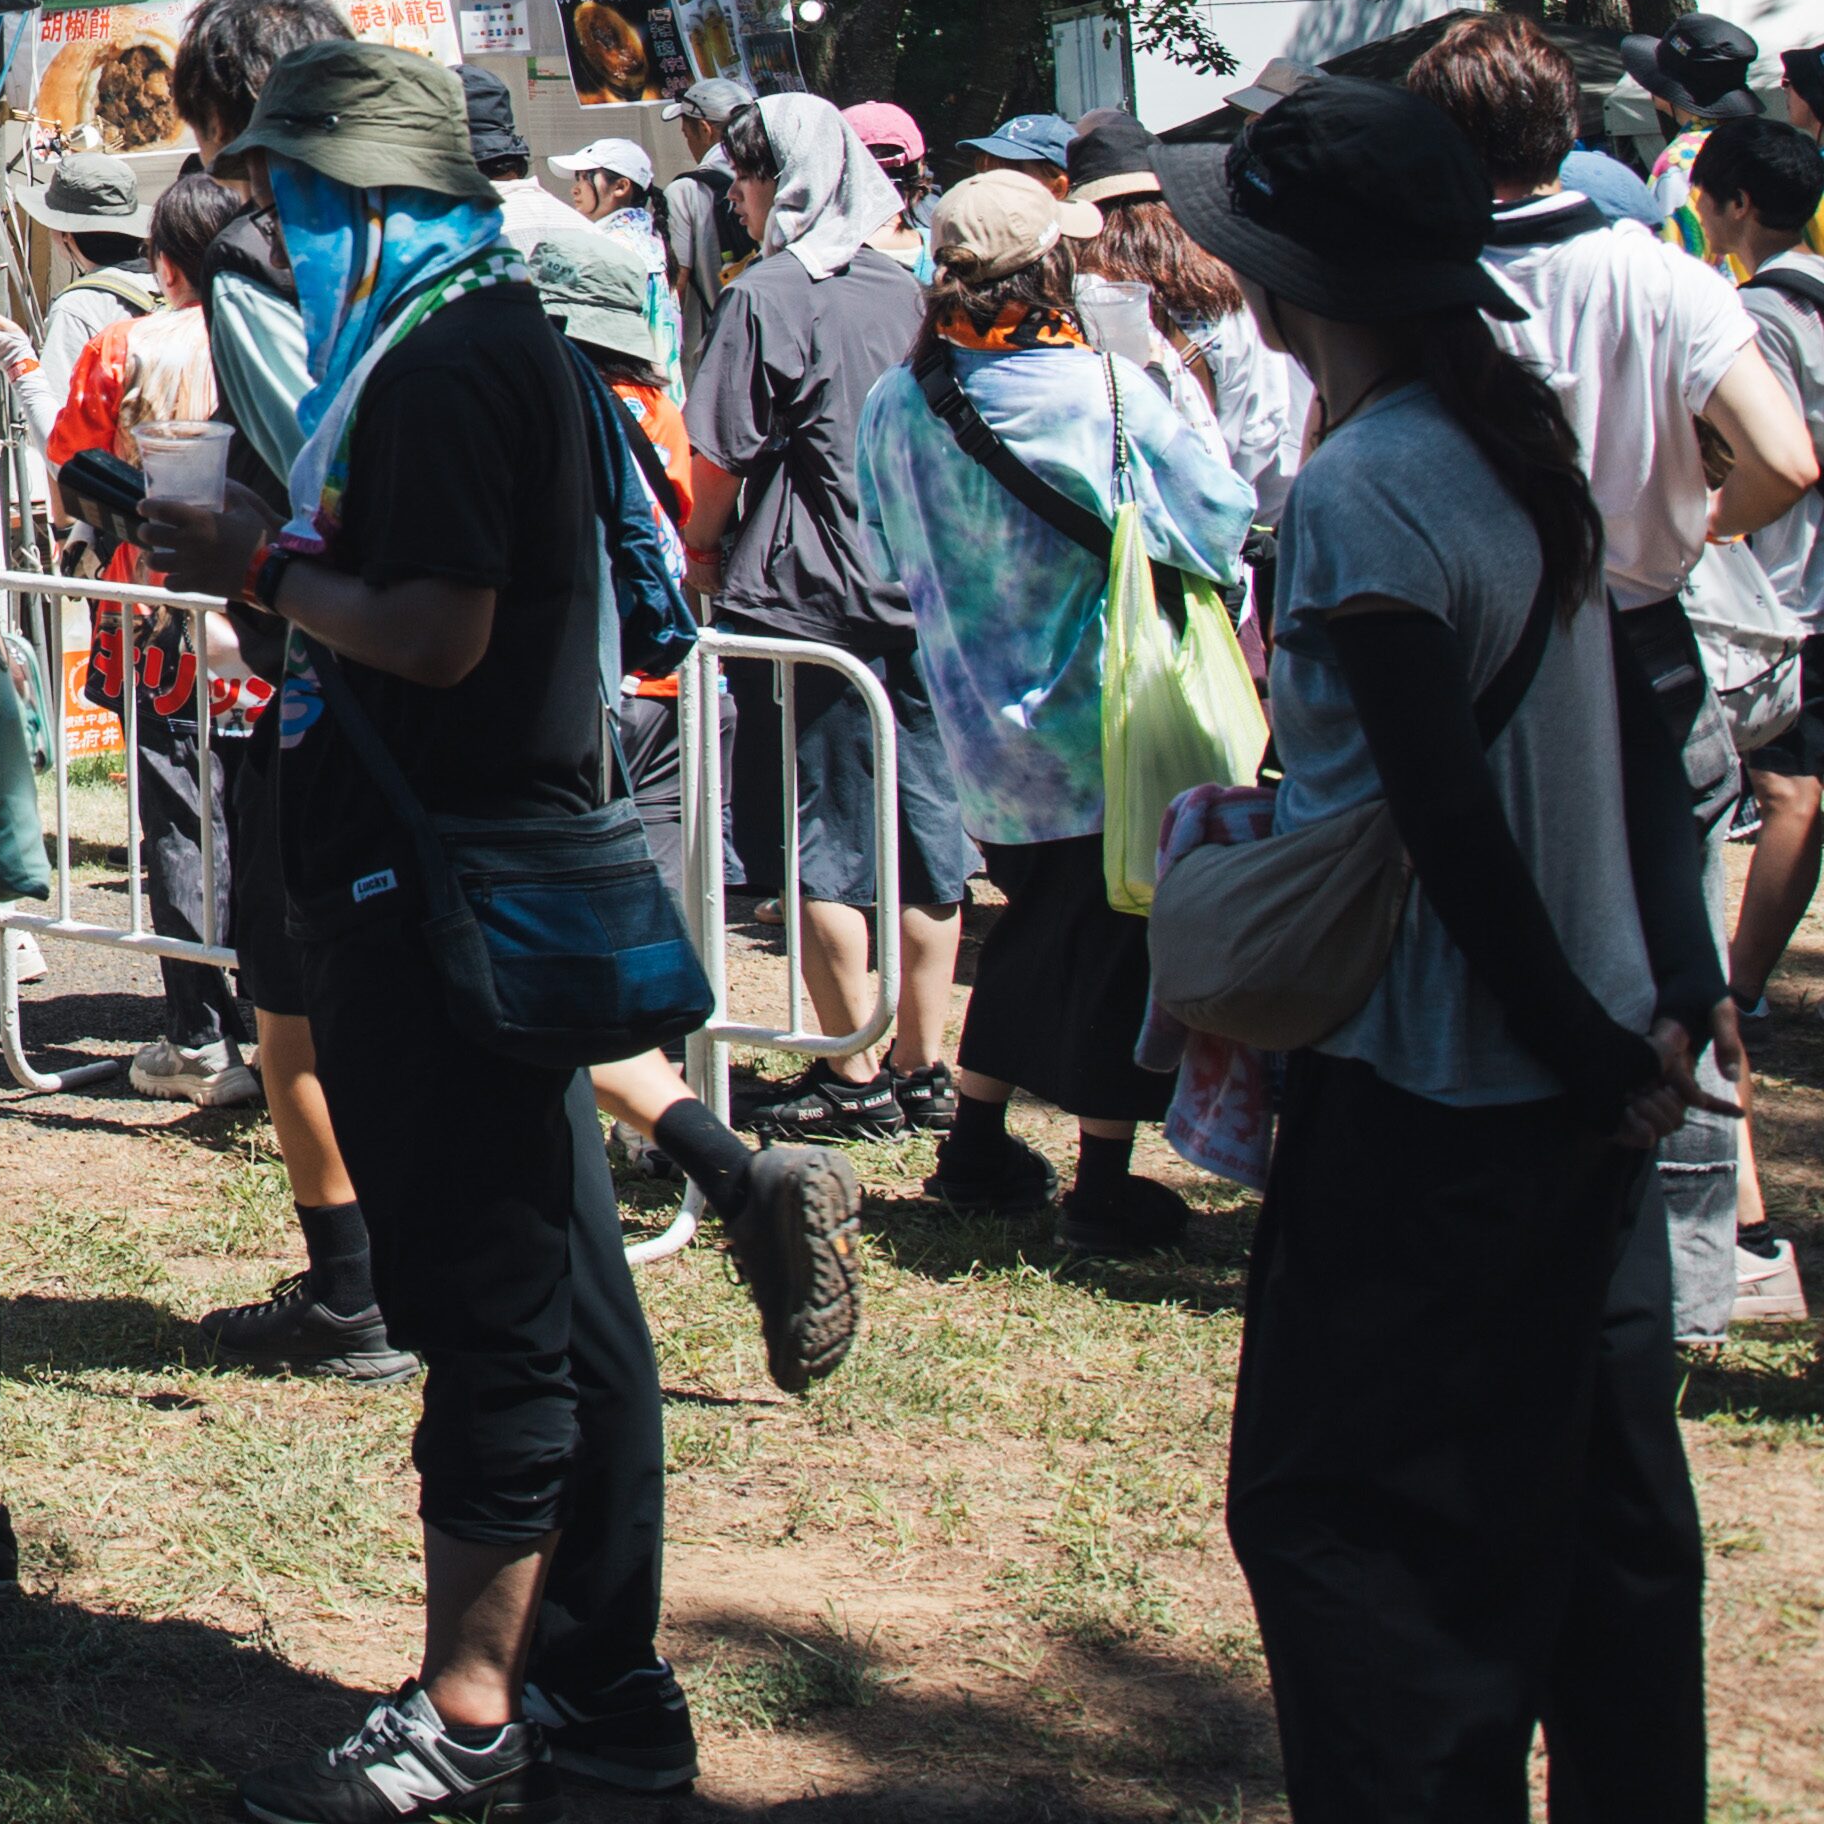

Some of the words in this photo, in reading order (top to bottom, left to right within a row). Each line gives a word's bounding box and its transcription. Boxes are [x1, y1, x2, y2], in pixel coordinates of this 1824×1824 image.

[41, 7, 112, 43] 胡椒餅
[356, 875, 389, 894] Lucky
